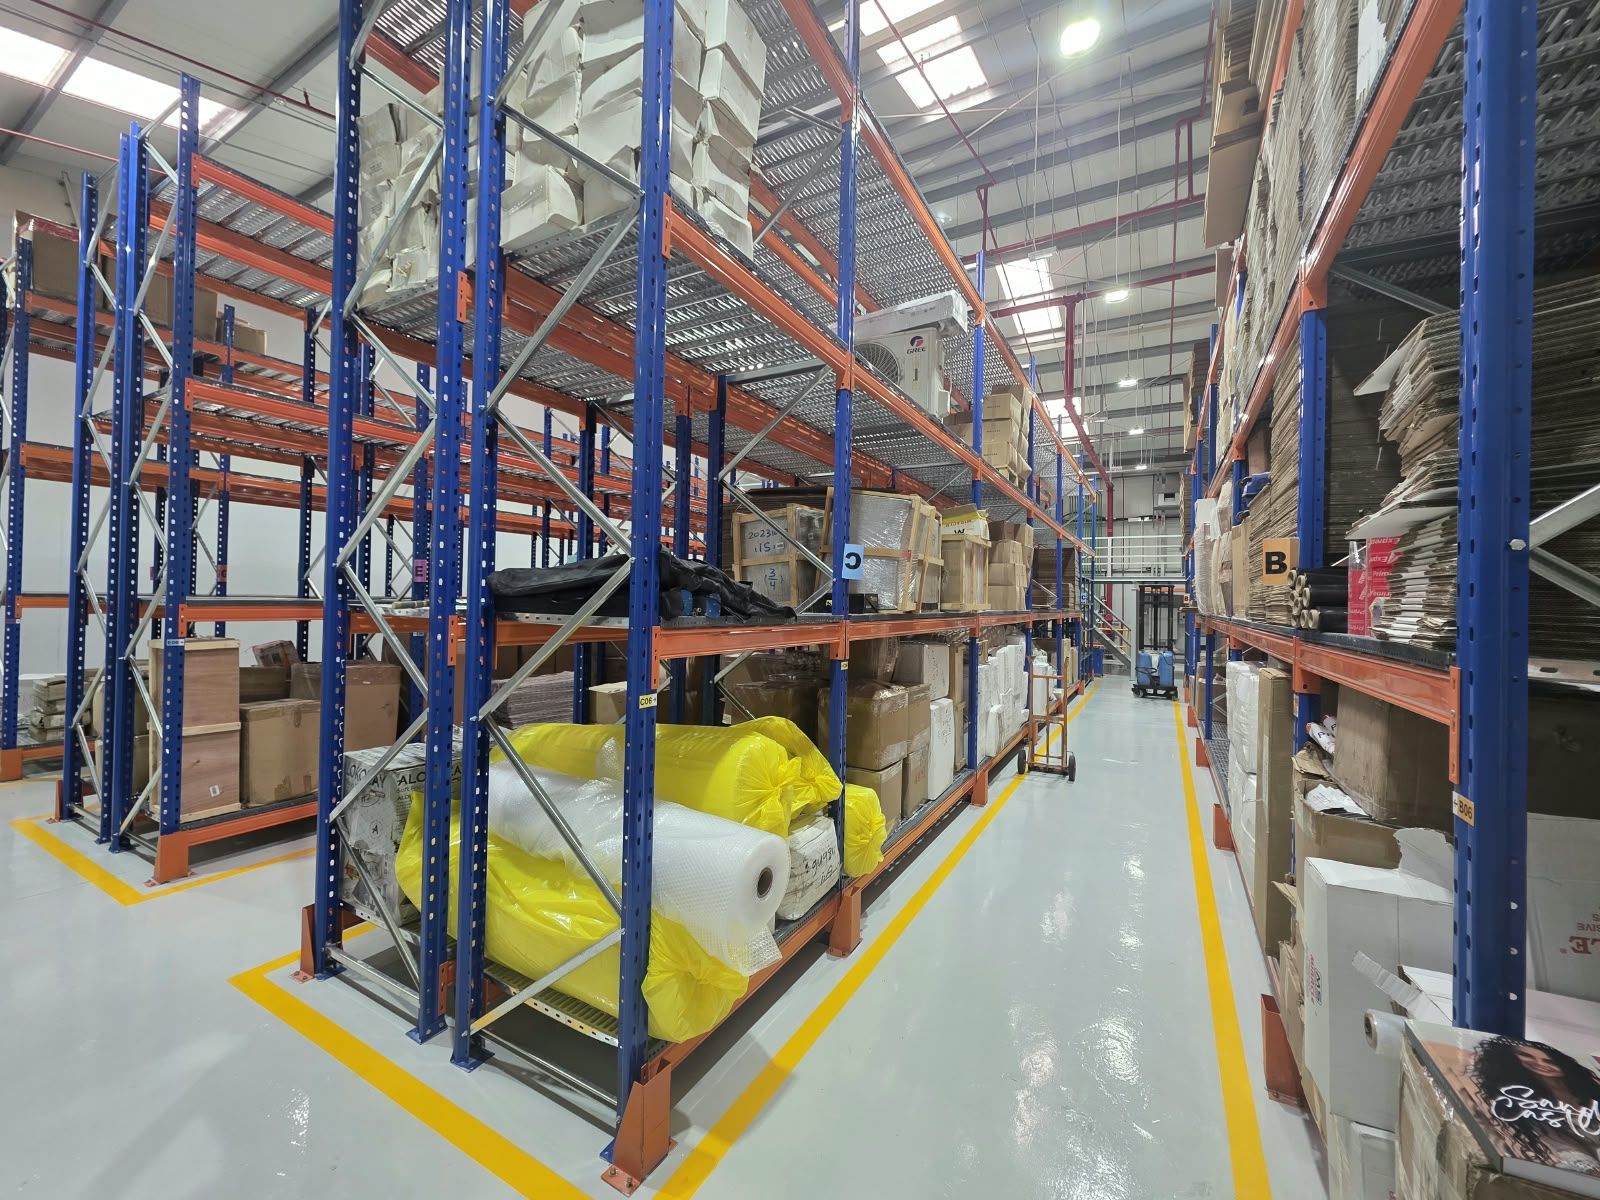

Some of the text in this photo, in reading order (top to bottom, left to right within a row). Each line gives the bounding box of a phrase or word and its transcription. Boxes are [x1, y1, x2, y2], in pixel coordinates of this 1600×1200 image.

[845, 552, 861, 569] C
[1265, 551, 1287, 574] B
[416, 565, 423, 577] E
[640, 697, 653, 706] C06
[1459, 800, 1473, 819] B06
